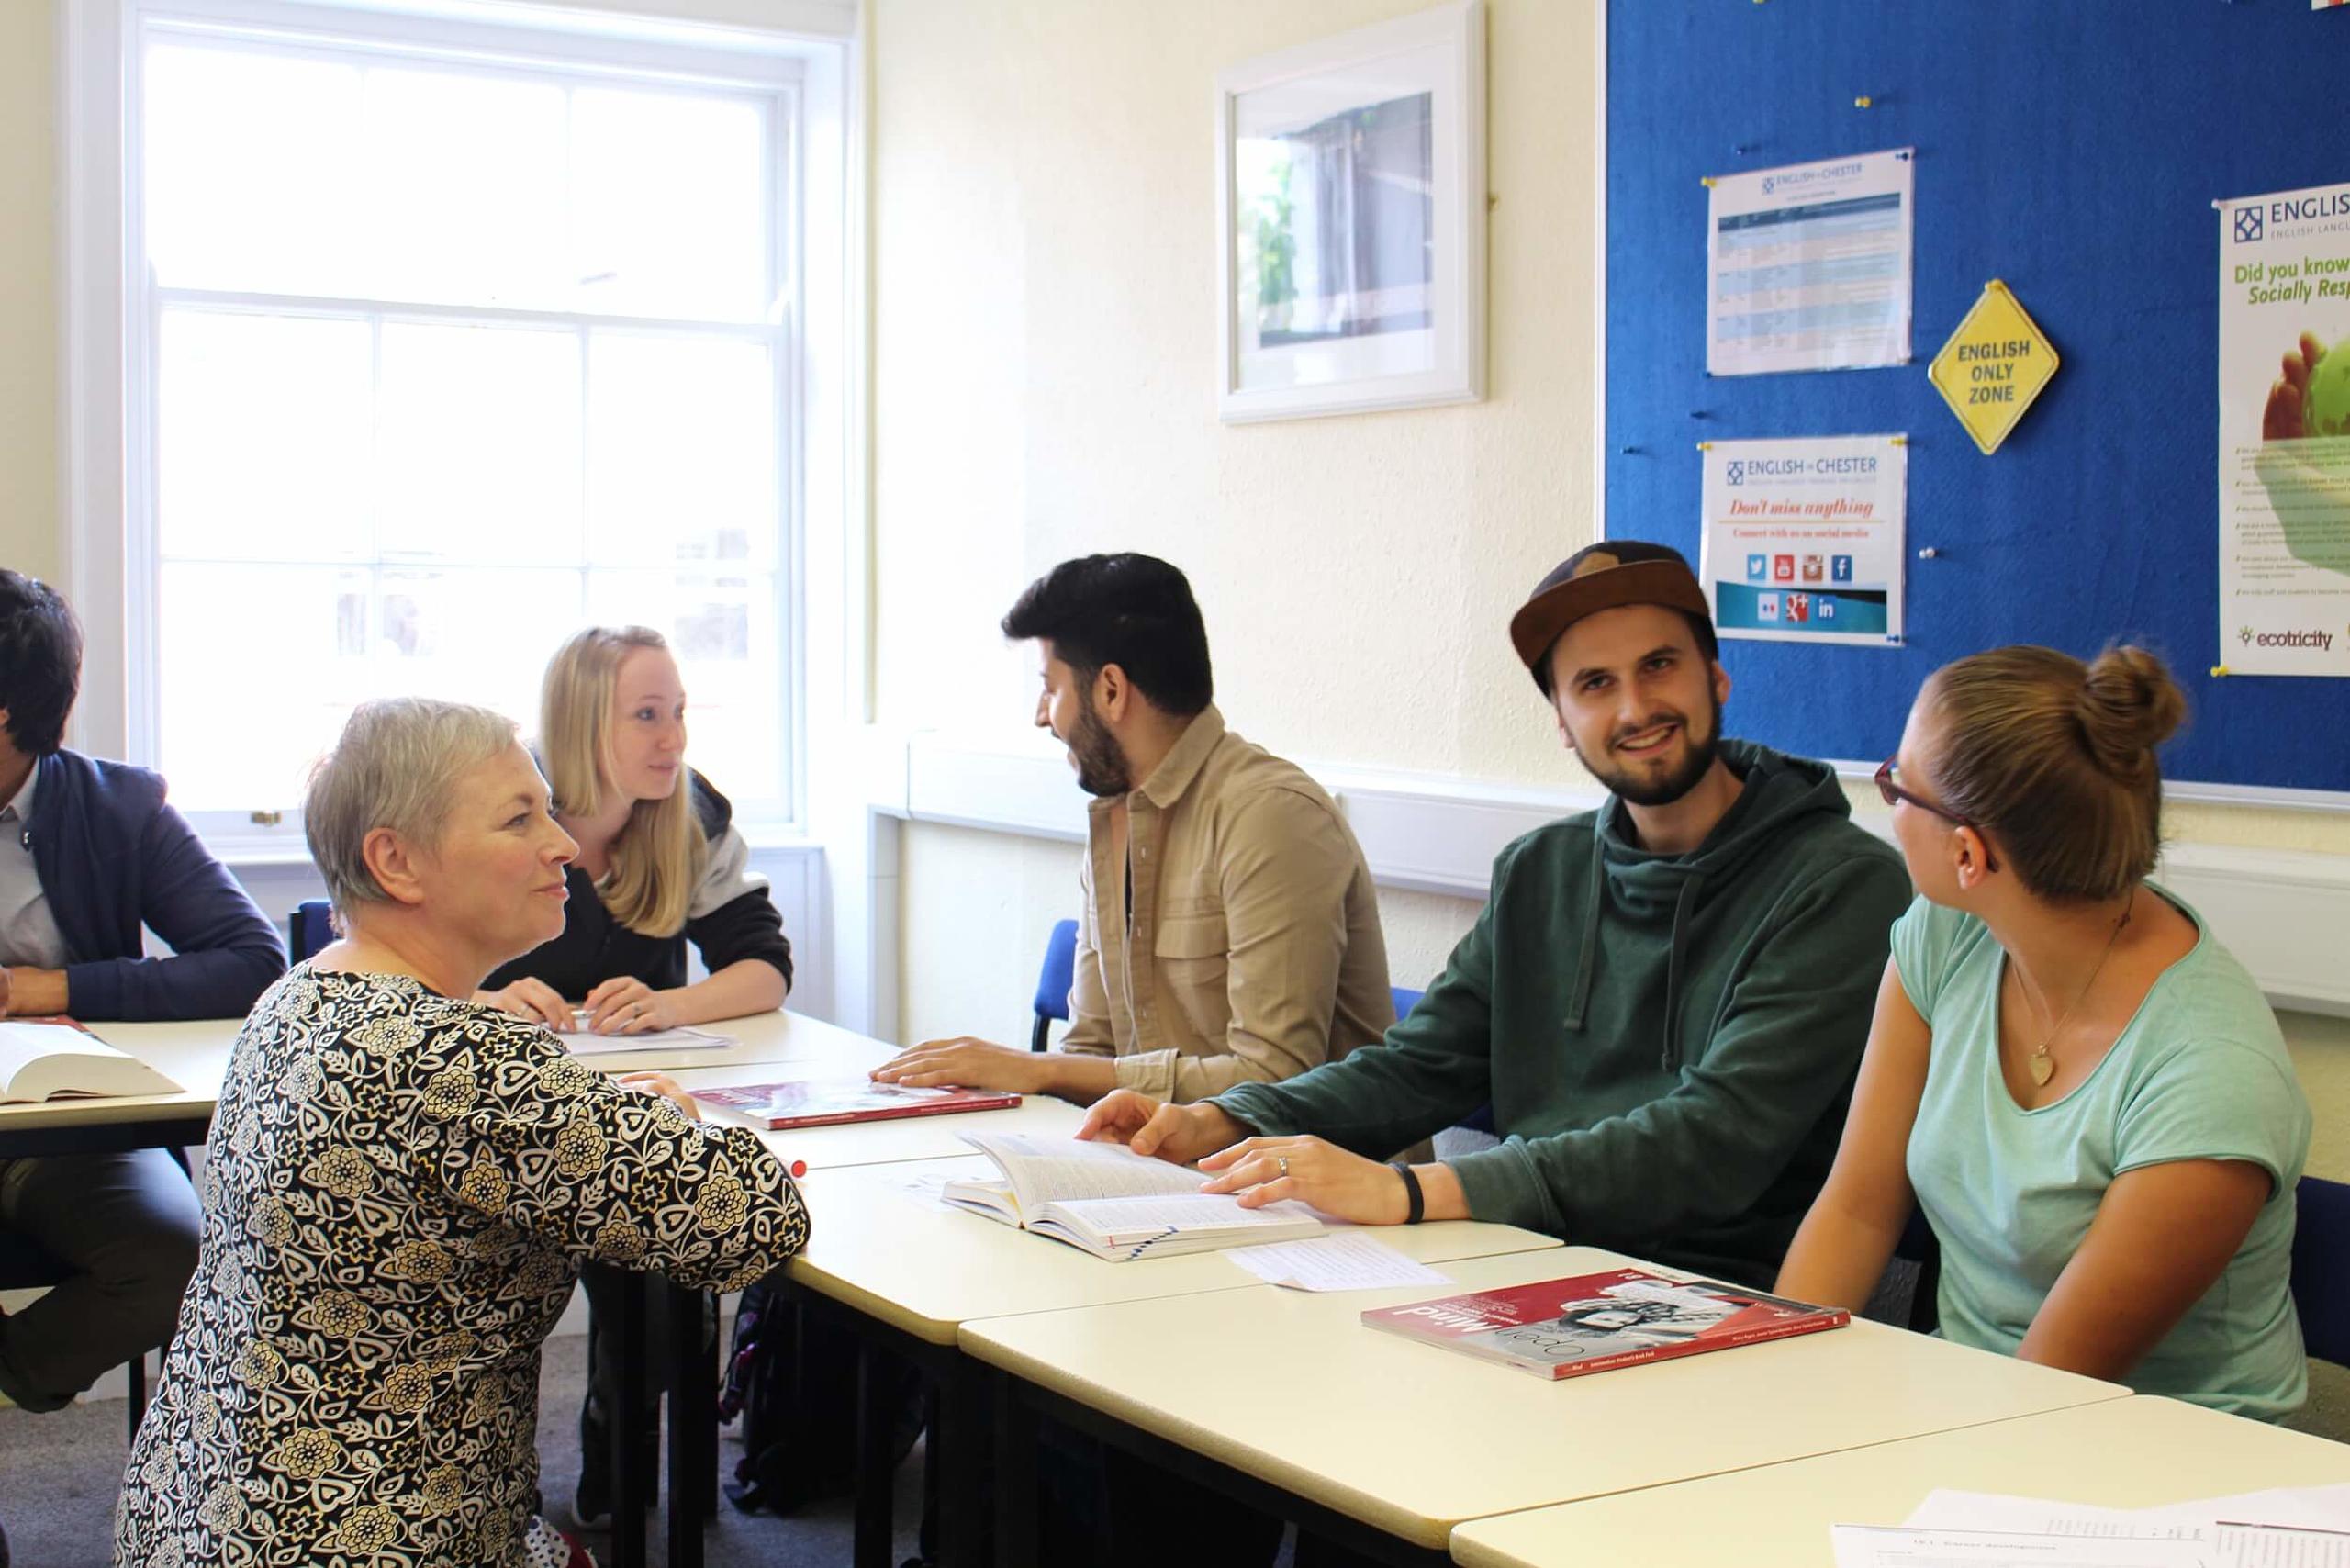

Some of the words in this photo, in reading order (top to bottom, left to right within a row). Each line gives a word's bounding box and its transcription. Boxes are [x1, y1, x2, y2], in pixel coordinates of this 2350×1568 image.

[1820, 162, 1863, 180] CHESTER
[2271, 228, 2314, 240] ENGLISH
[2235, 262, 2264, 285] Did
[2269, 263, 2299, 286] you
[2303, 255, 2350, 276] know
[2248, 279, 2312, 305] Socially
[1958, 340, 2031, 362] ENGLISH
[1971, 364, 2015, 382] ONLY
[1969, 385, 2015, 405] ZONE
[1747, 459, 1805, 475] ENGLISH
[1816, 457, 1877, 473] CHESTER
[1730, 499, 1767, 515] Don't
[1770, 499, 1801, 514] miss
[1804, 498, 1874, 519] anything
[2256, 629, 2333, 652] ecotricity
[1393, 1305, 1503, 1333] Mind
